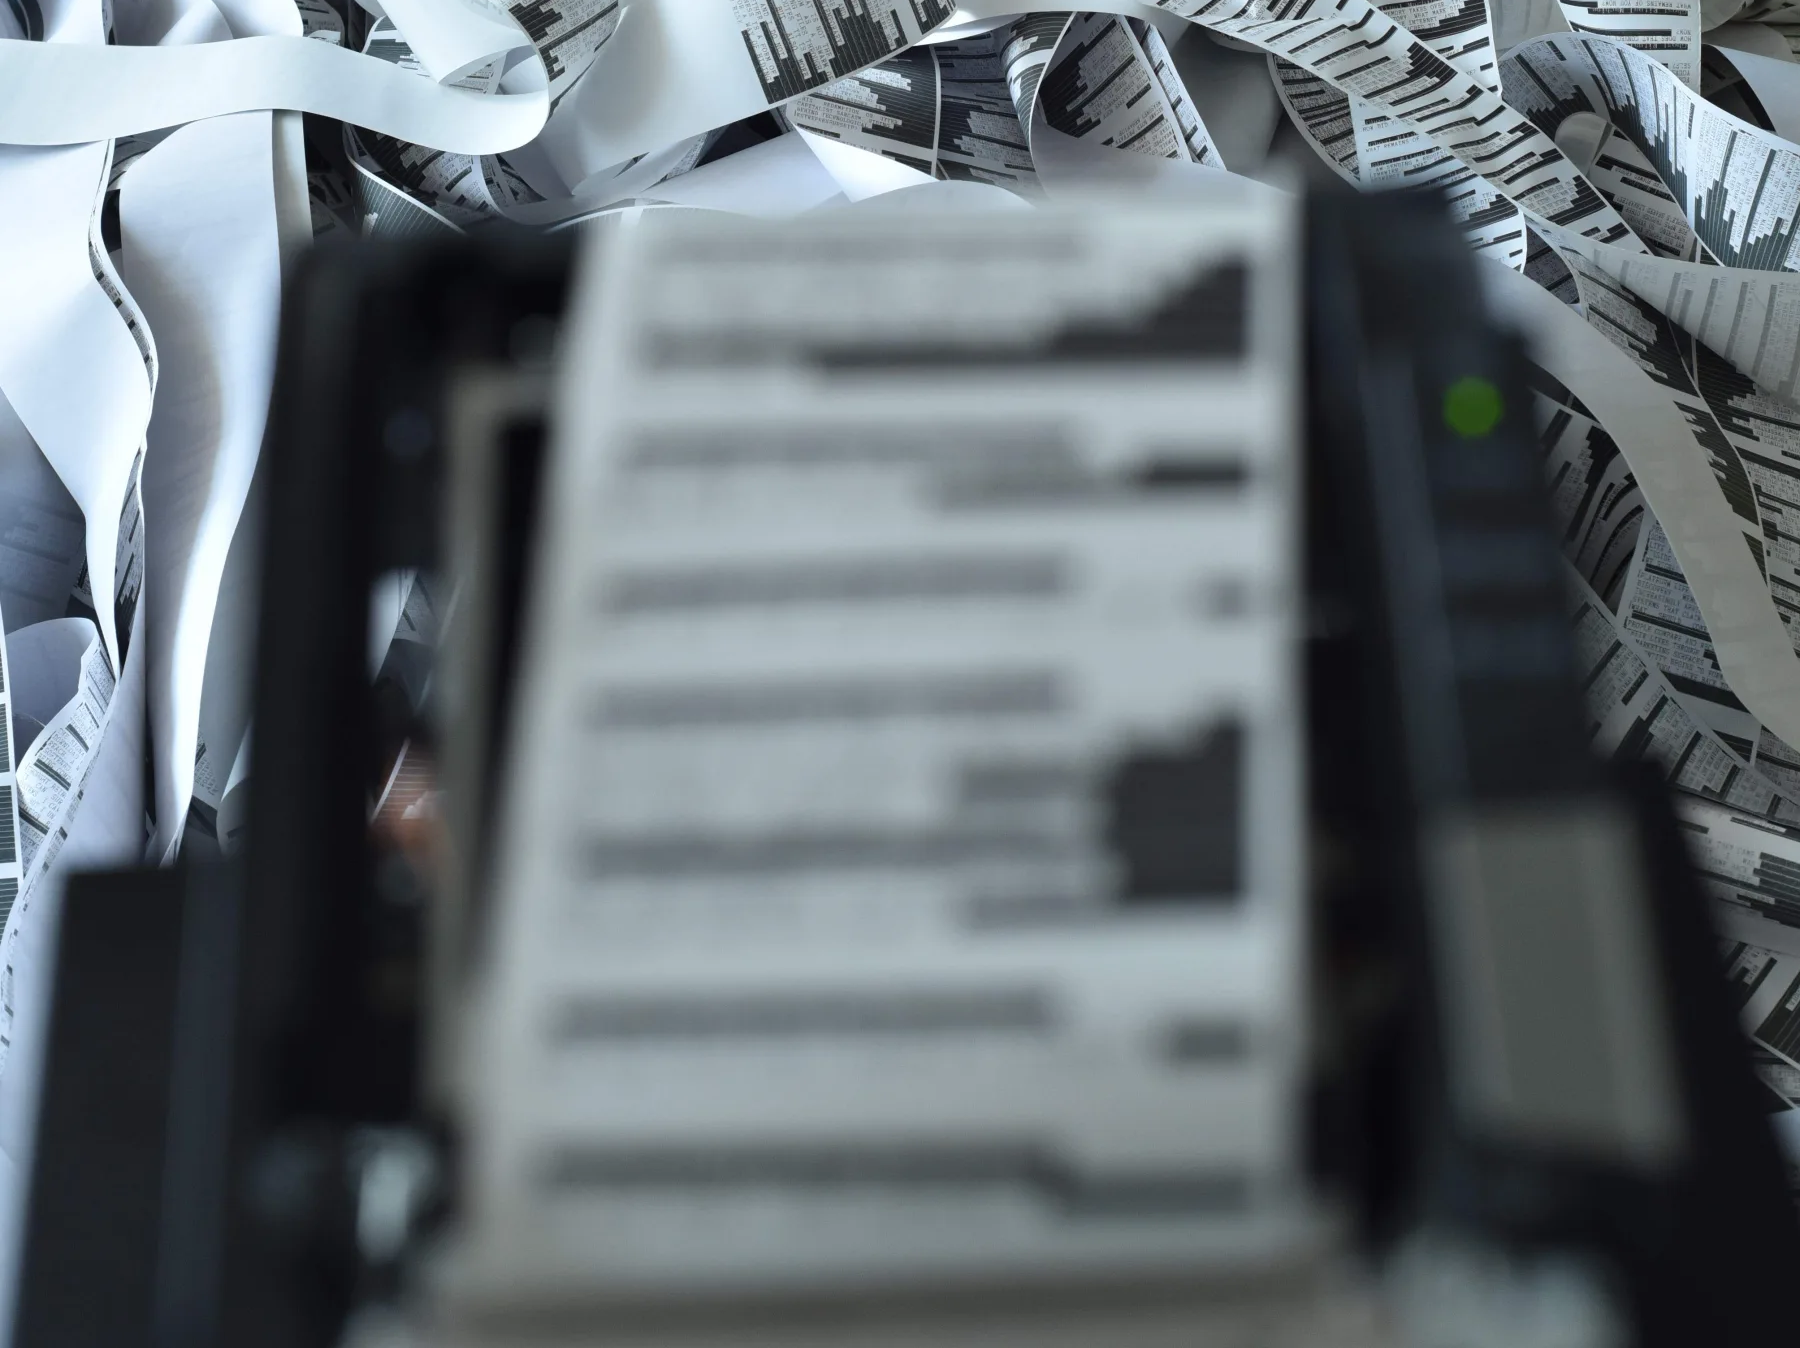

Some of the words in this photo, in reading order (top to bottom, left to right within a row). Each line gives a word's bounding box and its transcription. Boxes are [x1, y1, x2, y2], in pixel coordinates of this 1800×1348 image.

[1645, 0, 1673, 8] REMAINS
[759, 1, 770, 17] AND
[774, 41, 785, 56] NOT
[786, 31, 799, 51] ALSO
[802, 14, 812, 25] AS
[814, 44, 829, 69] SWARM
[814, 24, 825, 39] NOT
[821, 42, 832, 57] THE
[1383, 138, 1409, 148] REMAINS
